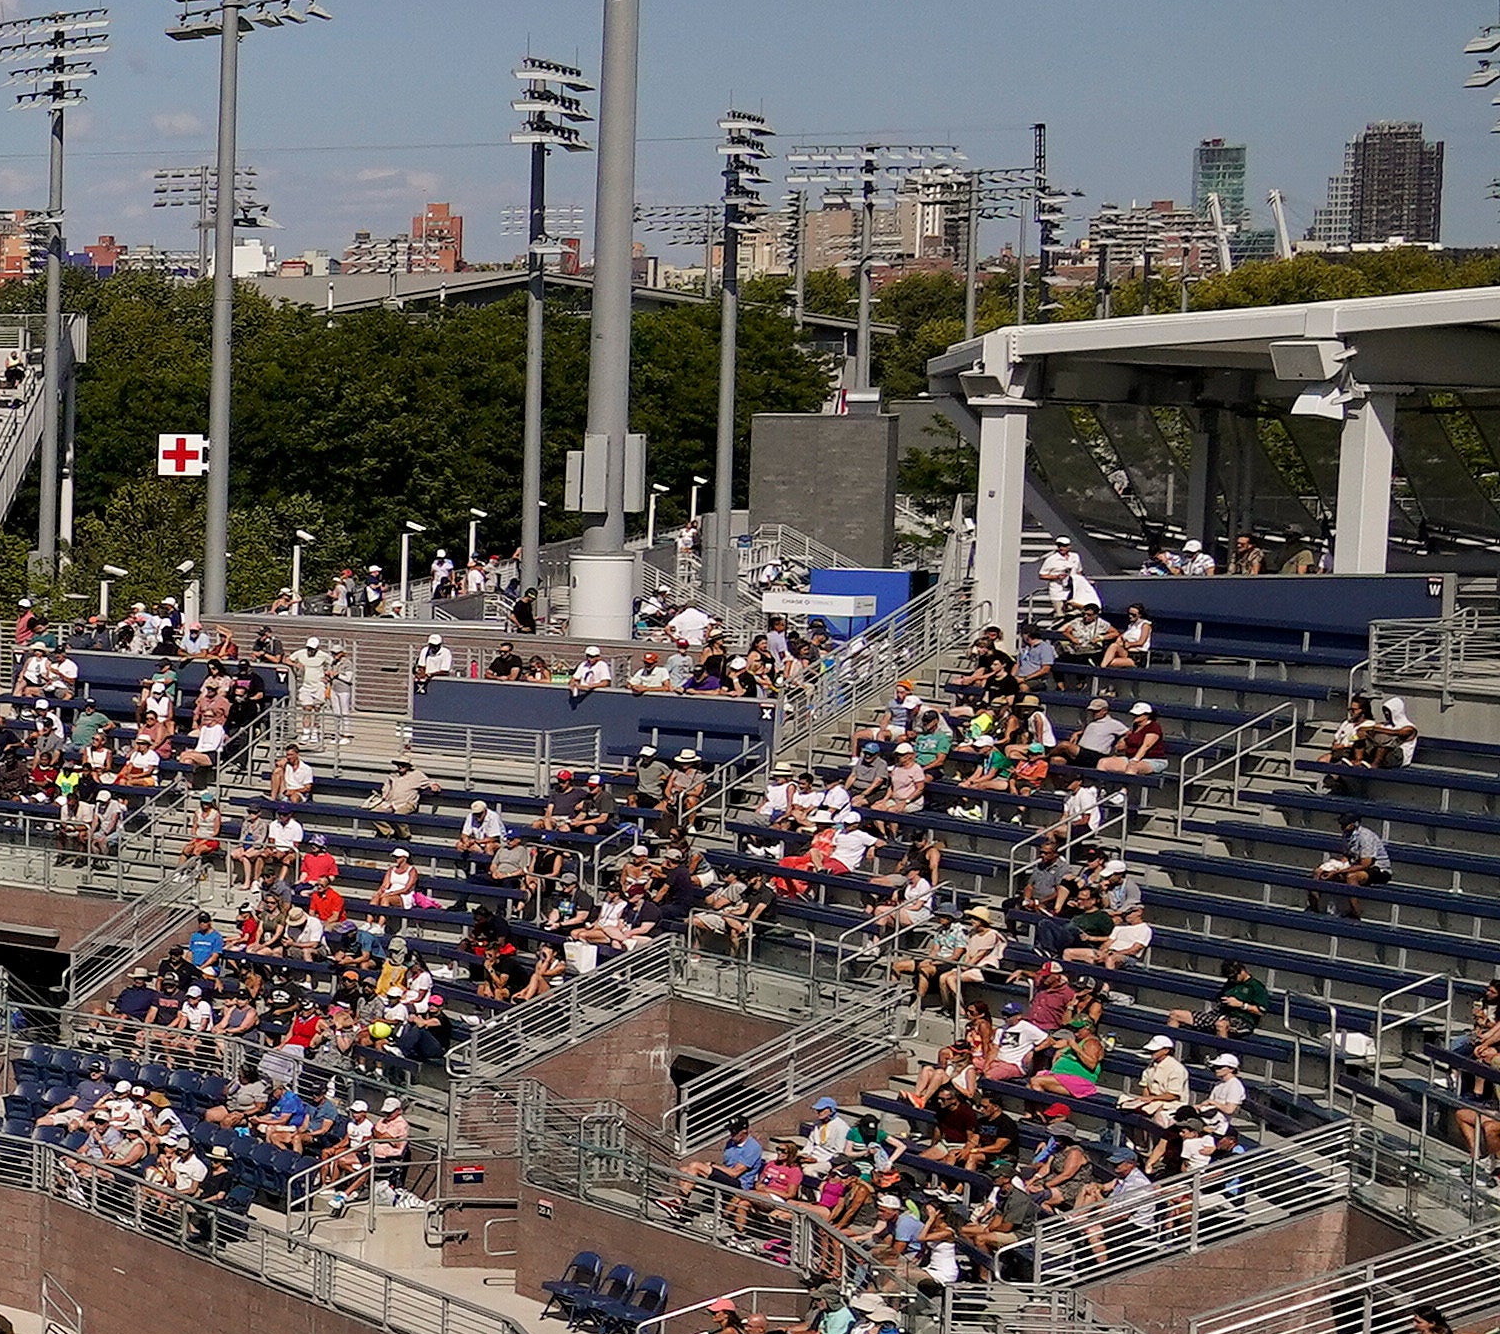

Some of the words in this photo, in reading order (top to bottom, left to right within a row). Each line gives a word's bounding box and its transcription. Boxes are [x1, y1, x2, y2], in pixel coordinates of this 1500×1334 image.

[1429, 584, 1441, 596] W
[14, 654, 23, 664] Y
[277, 672, 288, 682] Y
[762, 709, 772, 720] X
